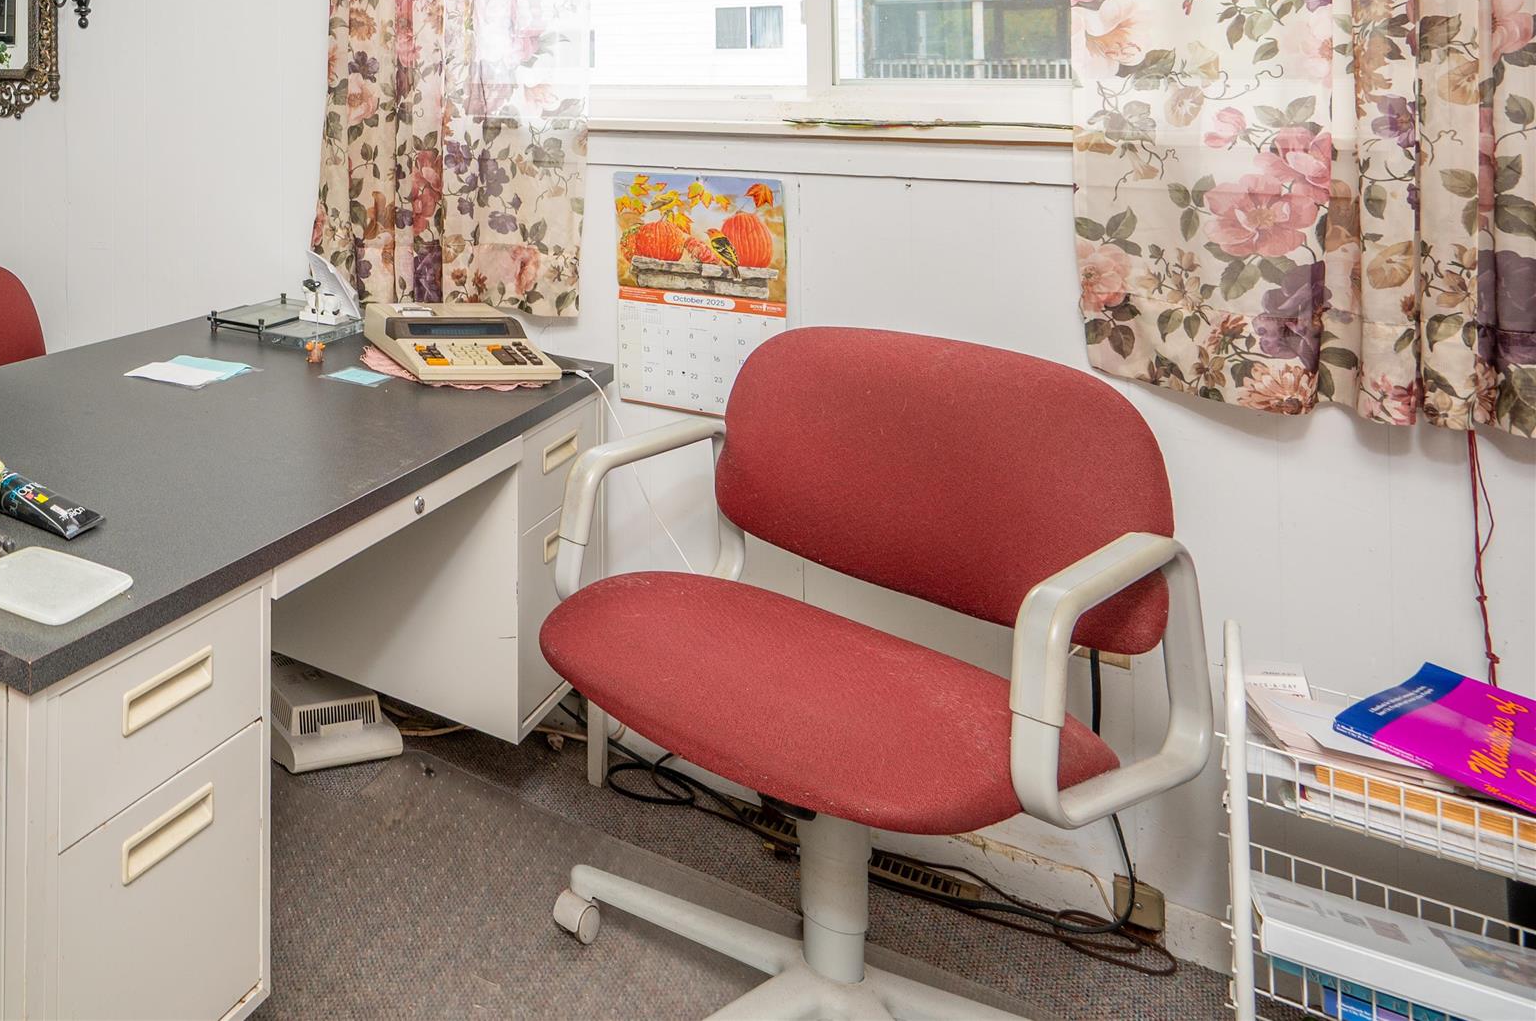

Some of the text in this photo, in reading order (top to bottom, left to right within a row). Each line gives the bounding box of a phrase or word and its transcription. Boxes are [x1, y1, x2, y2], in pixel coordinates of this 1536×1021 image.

[672, 294, 726, 307] October 2025
[1486, 693, 1529, 715] of
[1467, 715, 1515, 779] Ministries
